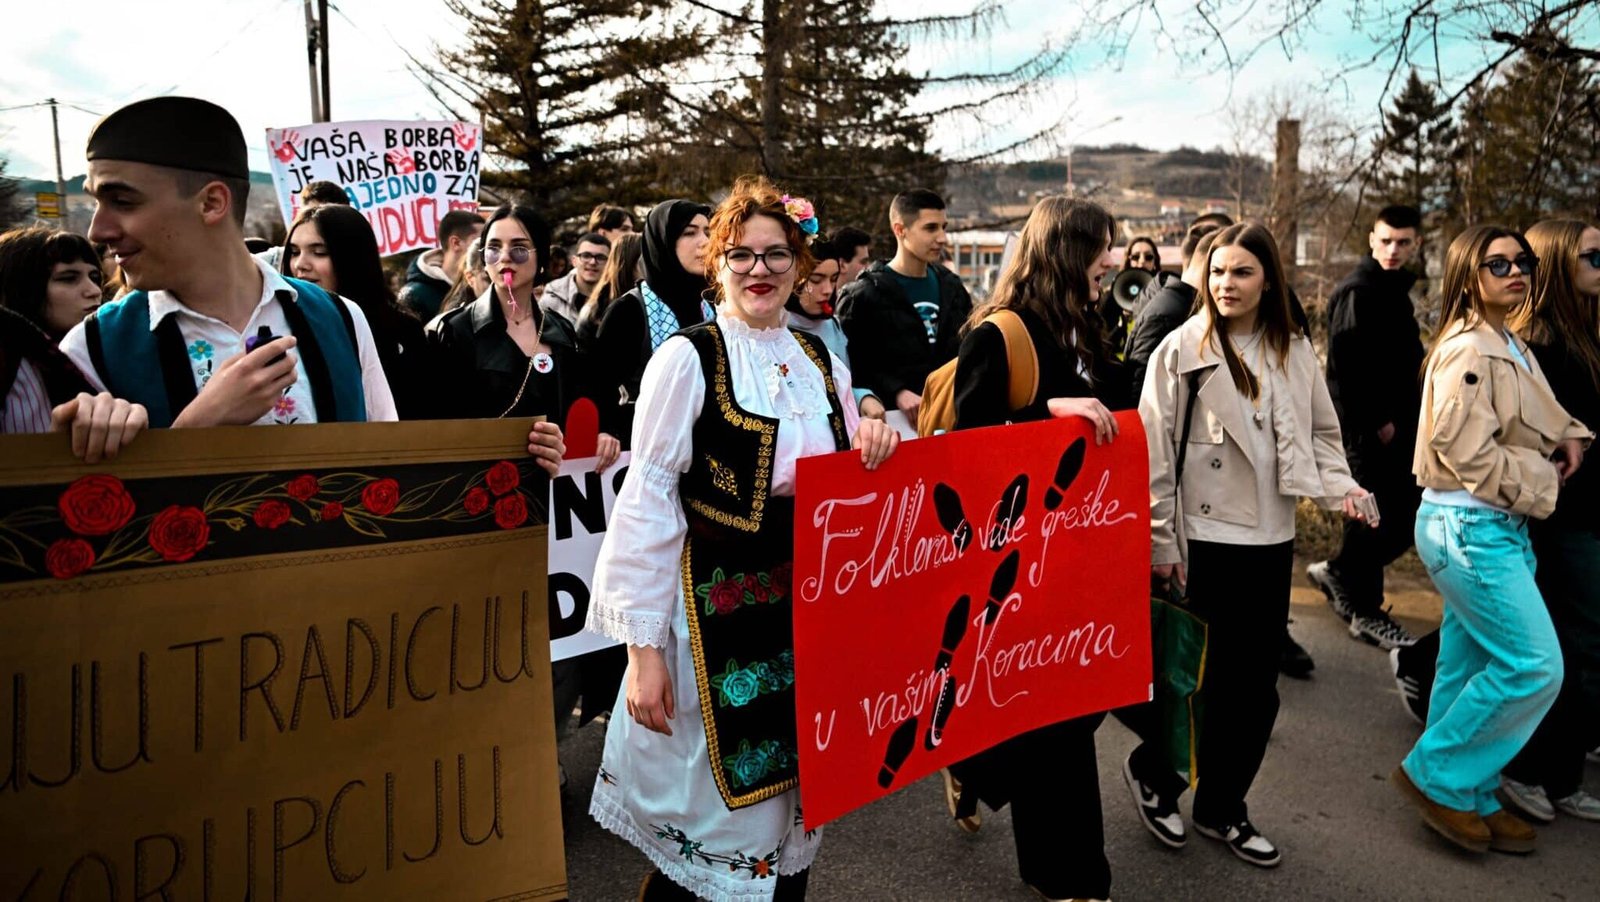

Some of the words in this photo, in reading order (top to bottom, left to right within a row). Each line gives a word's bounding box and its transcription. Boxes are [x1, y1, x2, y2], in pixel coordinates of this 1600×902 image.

[287, 128, 366, 161] VAŠA
[385, 127, 456, 149] BORBA
[337, 151, 397, 184] NAŠA
[415, 150, 479, 175] BORBA
[344, 172, 437, 211] AJEDNO
[445, 174, 476, 200] ZA
[553, 465, 630, 541] N
[1028, 469, 1138, 587] greške
[169, 590, 534, 754] TRADICIJU
[815, 709, 836, 751] u
[859, 662, 949, 746] vašim
